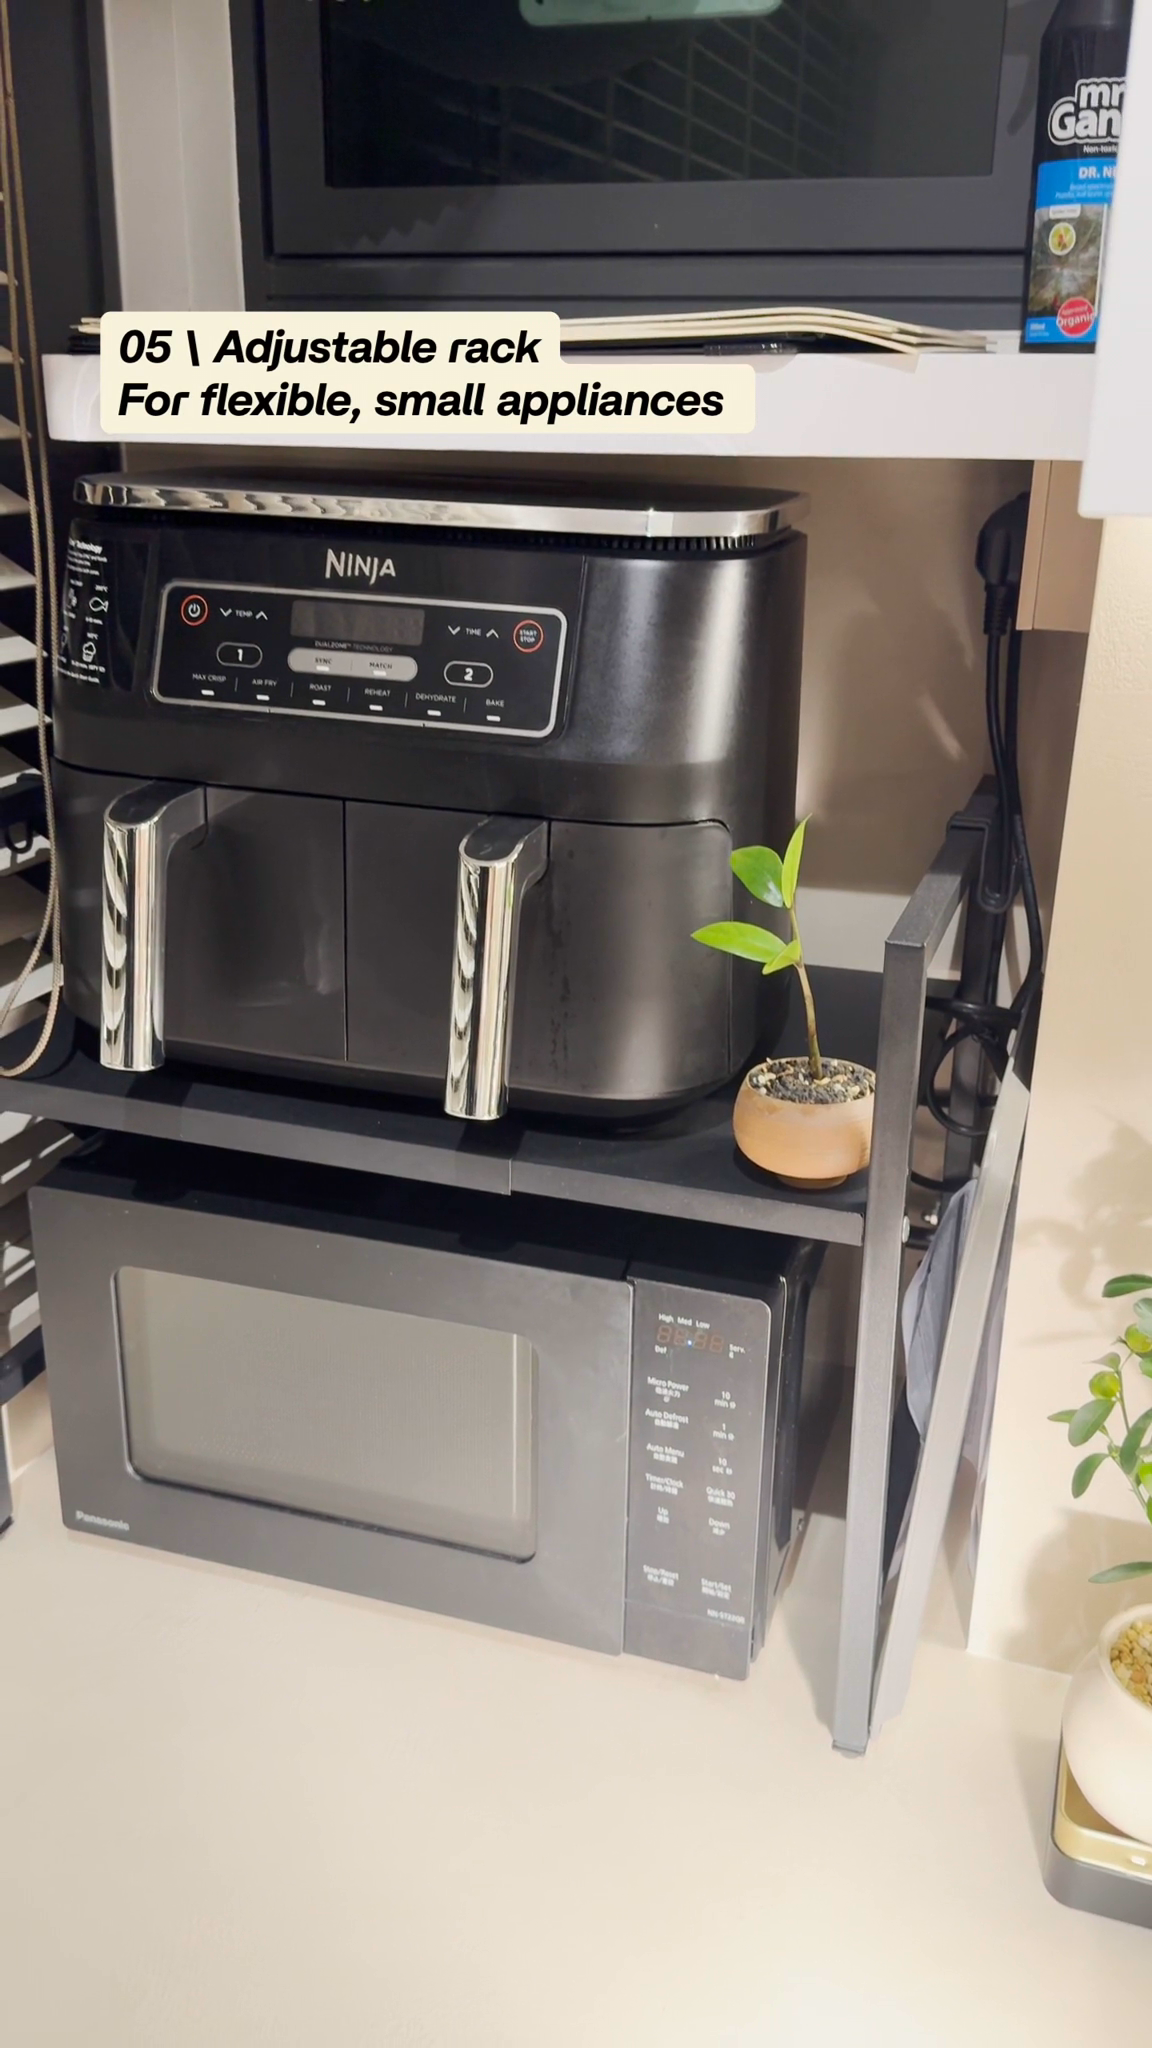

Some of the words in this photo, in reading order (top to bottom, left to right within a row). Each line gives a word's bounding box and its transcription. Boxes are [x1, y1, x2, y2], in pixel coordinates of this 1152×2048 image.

[1078, 165, 1100, 179] DR.
[325, 548, 396, 585] NINJA
[235, 610, 253, 618] TEMP
[465, 628, 481, 636] TIME
[353, 643, 394, 653] TECHNOLOGY
[237, 648, 243, 662] 1
[315, 657, 332, 665] SYNC
[369, 661, 393, 670] MATCH
[192, 673, 206, 681] MAX
[207, 674, 227, 683] CRISP
[464, 667, 473, 681] 2
[252, 678, 264, 686] AIR
[264, 679, 277, 687] FRY
[309, 683, 332, 692] ROAST
[364, 687, 391, 697] REHEAT
[415, 692, 457, 704] DEHYDRATE
[485, 698, 505, 708] BAKE
[658, 1313, 674, 1324] High
[677, 1316, 692, 1327] Med
[696, 1320, 711, 1330] Low
[647, 1376, 667, 1388] Micro
[667, 1380, 689, 1392] Power
[722, 1391, 731, 1400] 10
[714, 1398, 729, 1408] min
[645, 1408, 663, 1419] Auto
[663, 1411, 689, 1425] Defrost
[713, 1430, 727, 1440] min
[646, 1443, 664, 1453] Auto
[664, 1446, 685, 1458] Menu
[718, 1457, 727, 1467] 10
[645, 1472, 684, 1489] Timer/Clock
[657, 1506, 669, 1516] Up
[75, 1510, 130, 1531] Panasonic
[708, 1517, 731, 1530] Down
